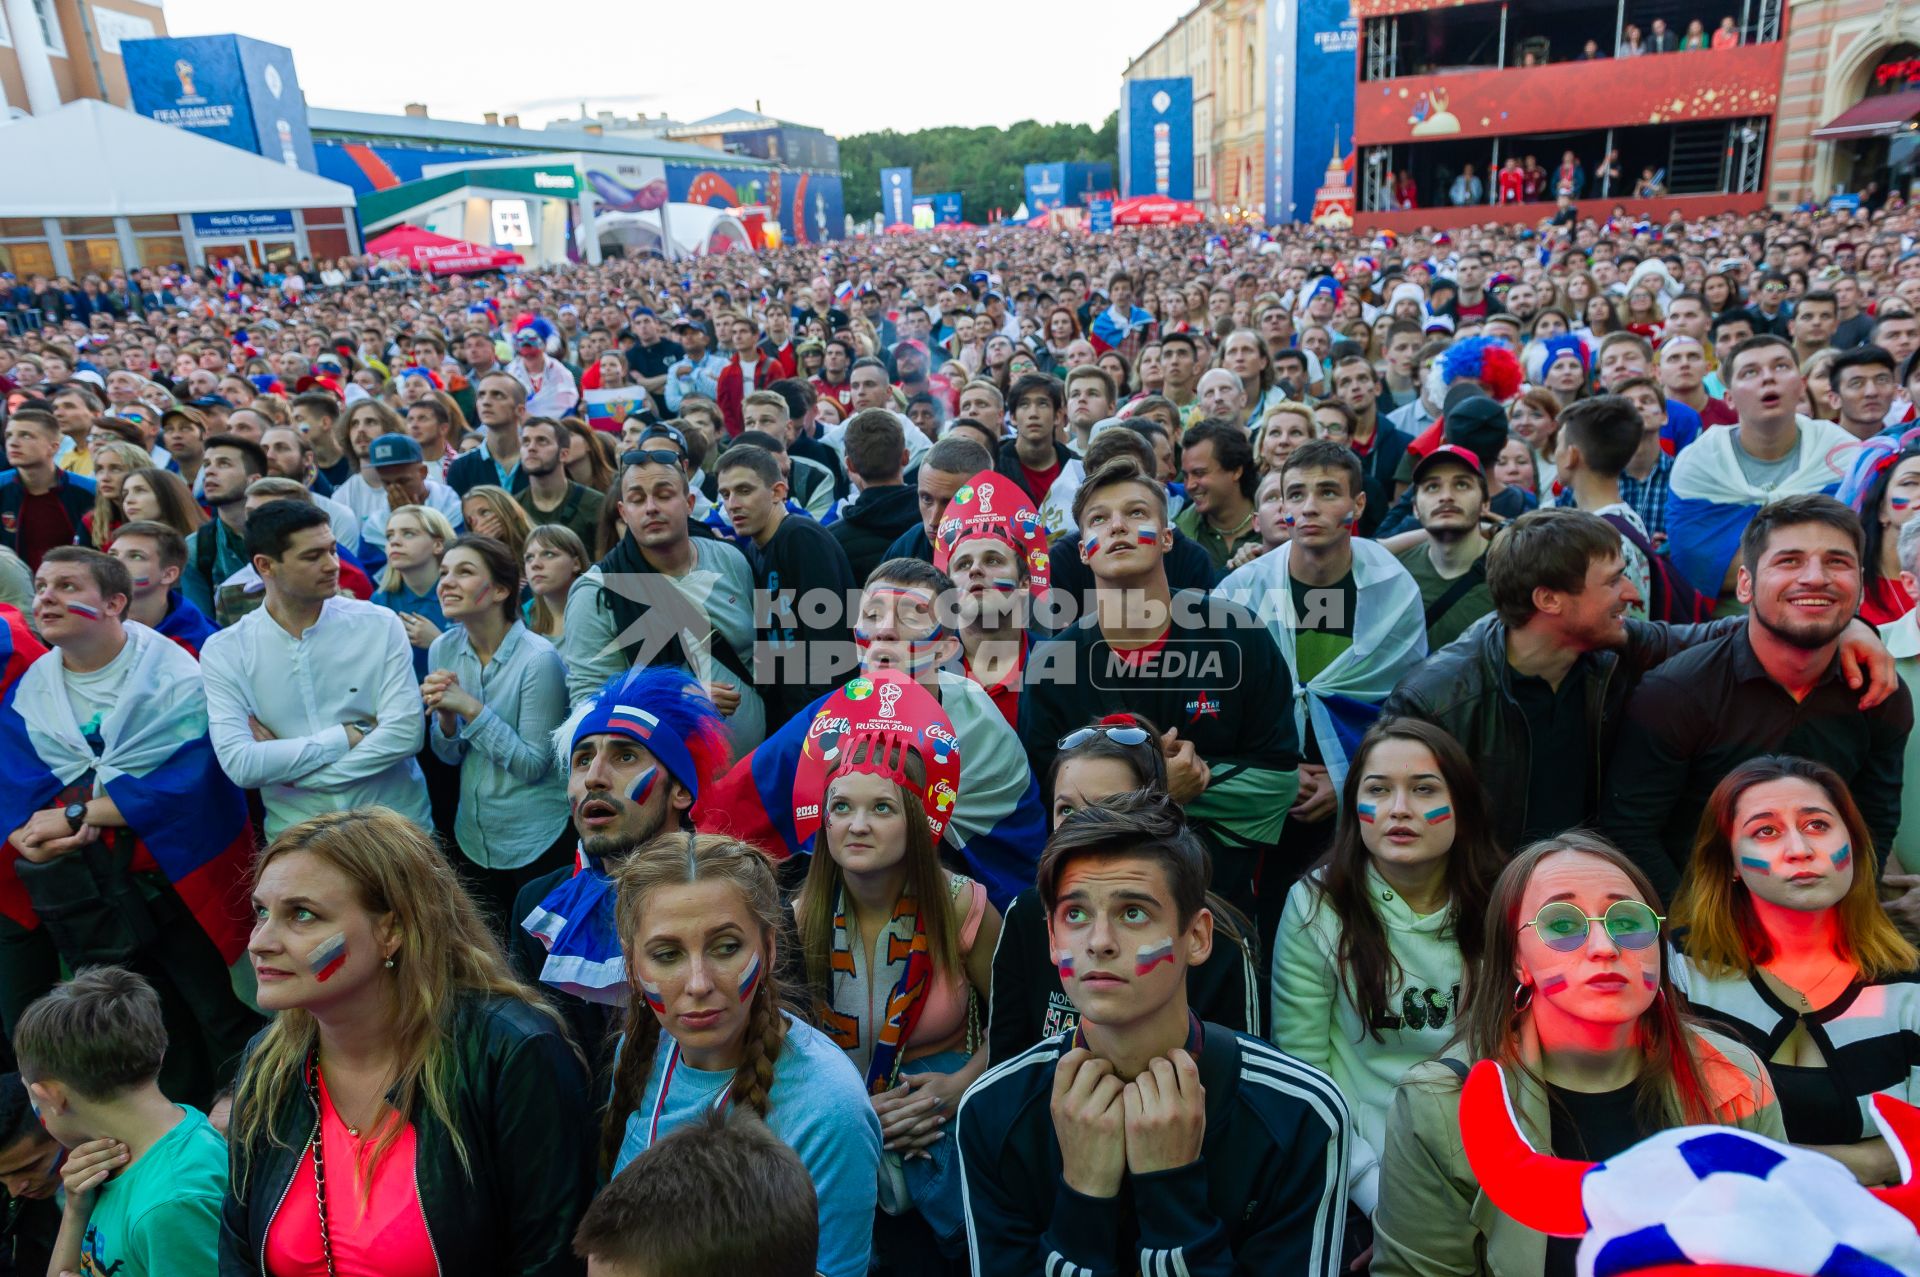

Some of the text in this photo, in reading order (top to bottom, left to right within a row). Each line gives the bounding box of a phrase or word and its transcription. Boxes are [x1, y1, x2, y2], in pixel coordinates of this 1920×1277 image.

[965, 516, 990, 525] RUSSIA
[1186, 701, 1220, 710] AIR STAR
[856, 722, 913, 733] RUSSIA 2018
[796, 804, 819, 818] 2018
[1049, 991, 1073, 1006] NOR
